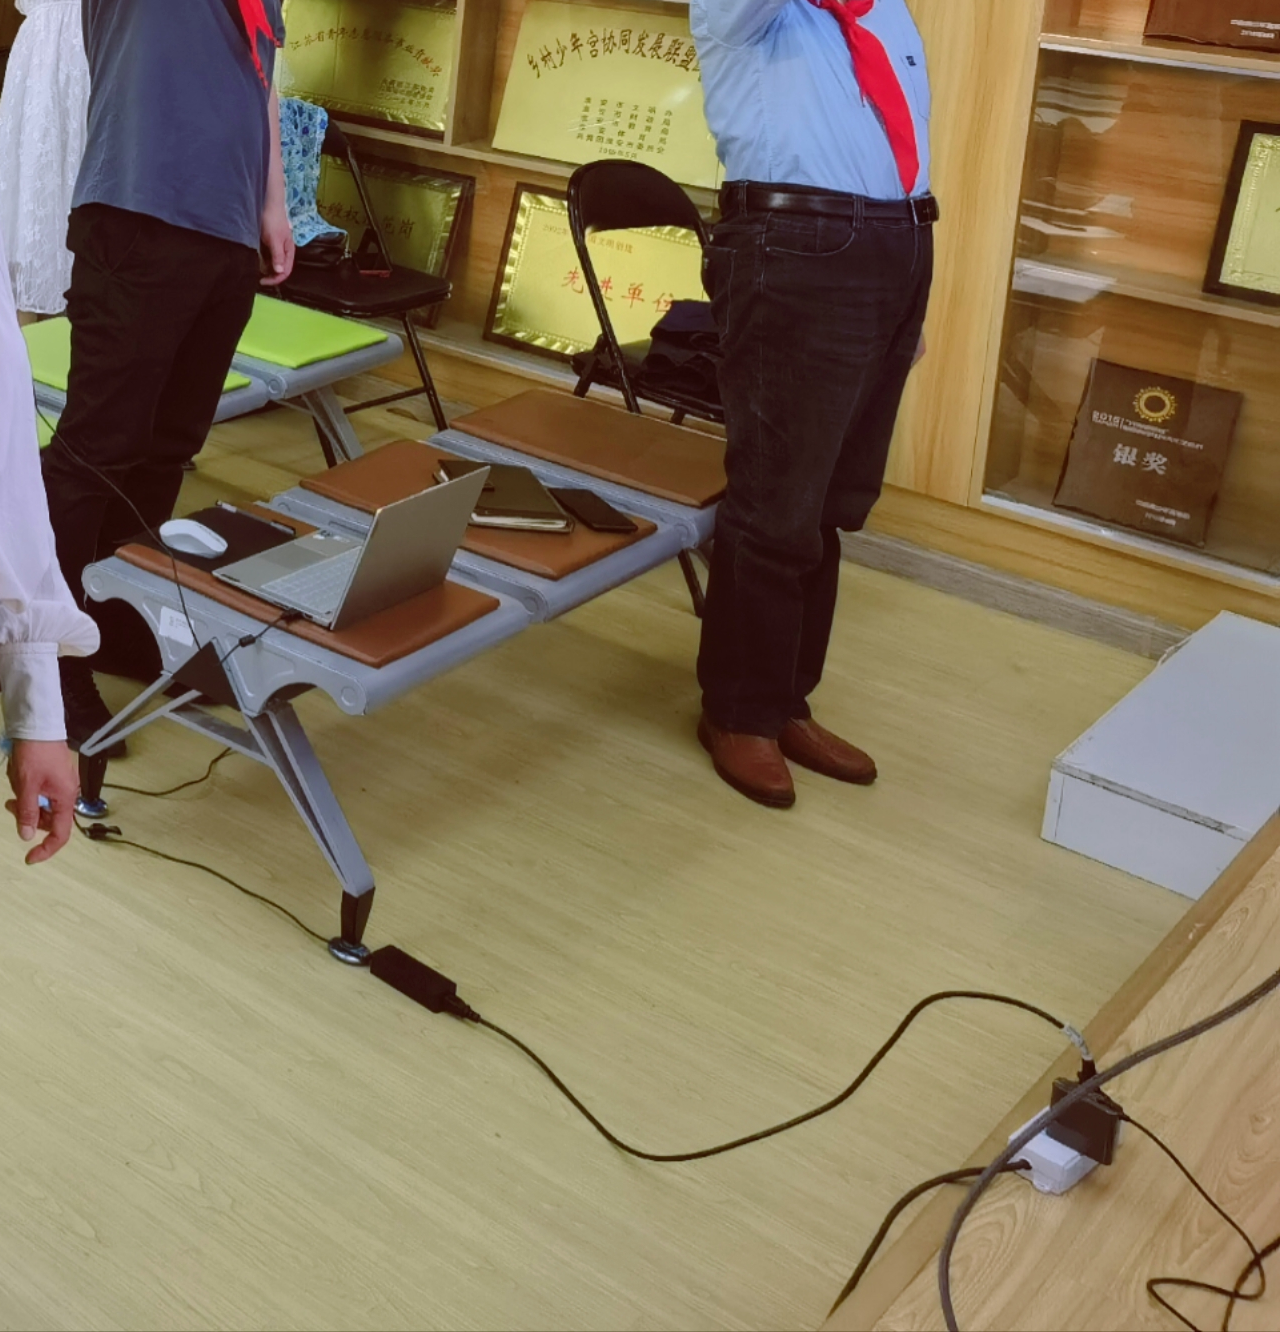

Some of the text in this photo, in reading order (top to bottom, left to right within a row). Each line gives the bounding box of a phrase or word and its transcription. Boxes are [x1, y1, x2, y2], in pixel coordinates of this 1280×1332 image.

[527, 28, 702, 82] 乡村少年宫协同发展联盟
[1113, 443, 1168, 475] 银奖
